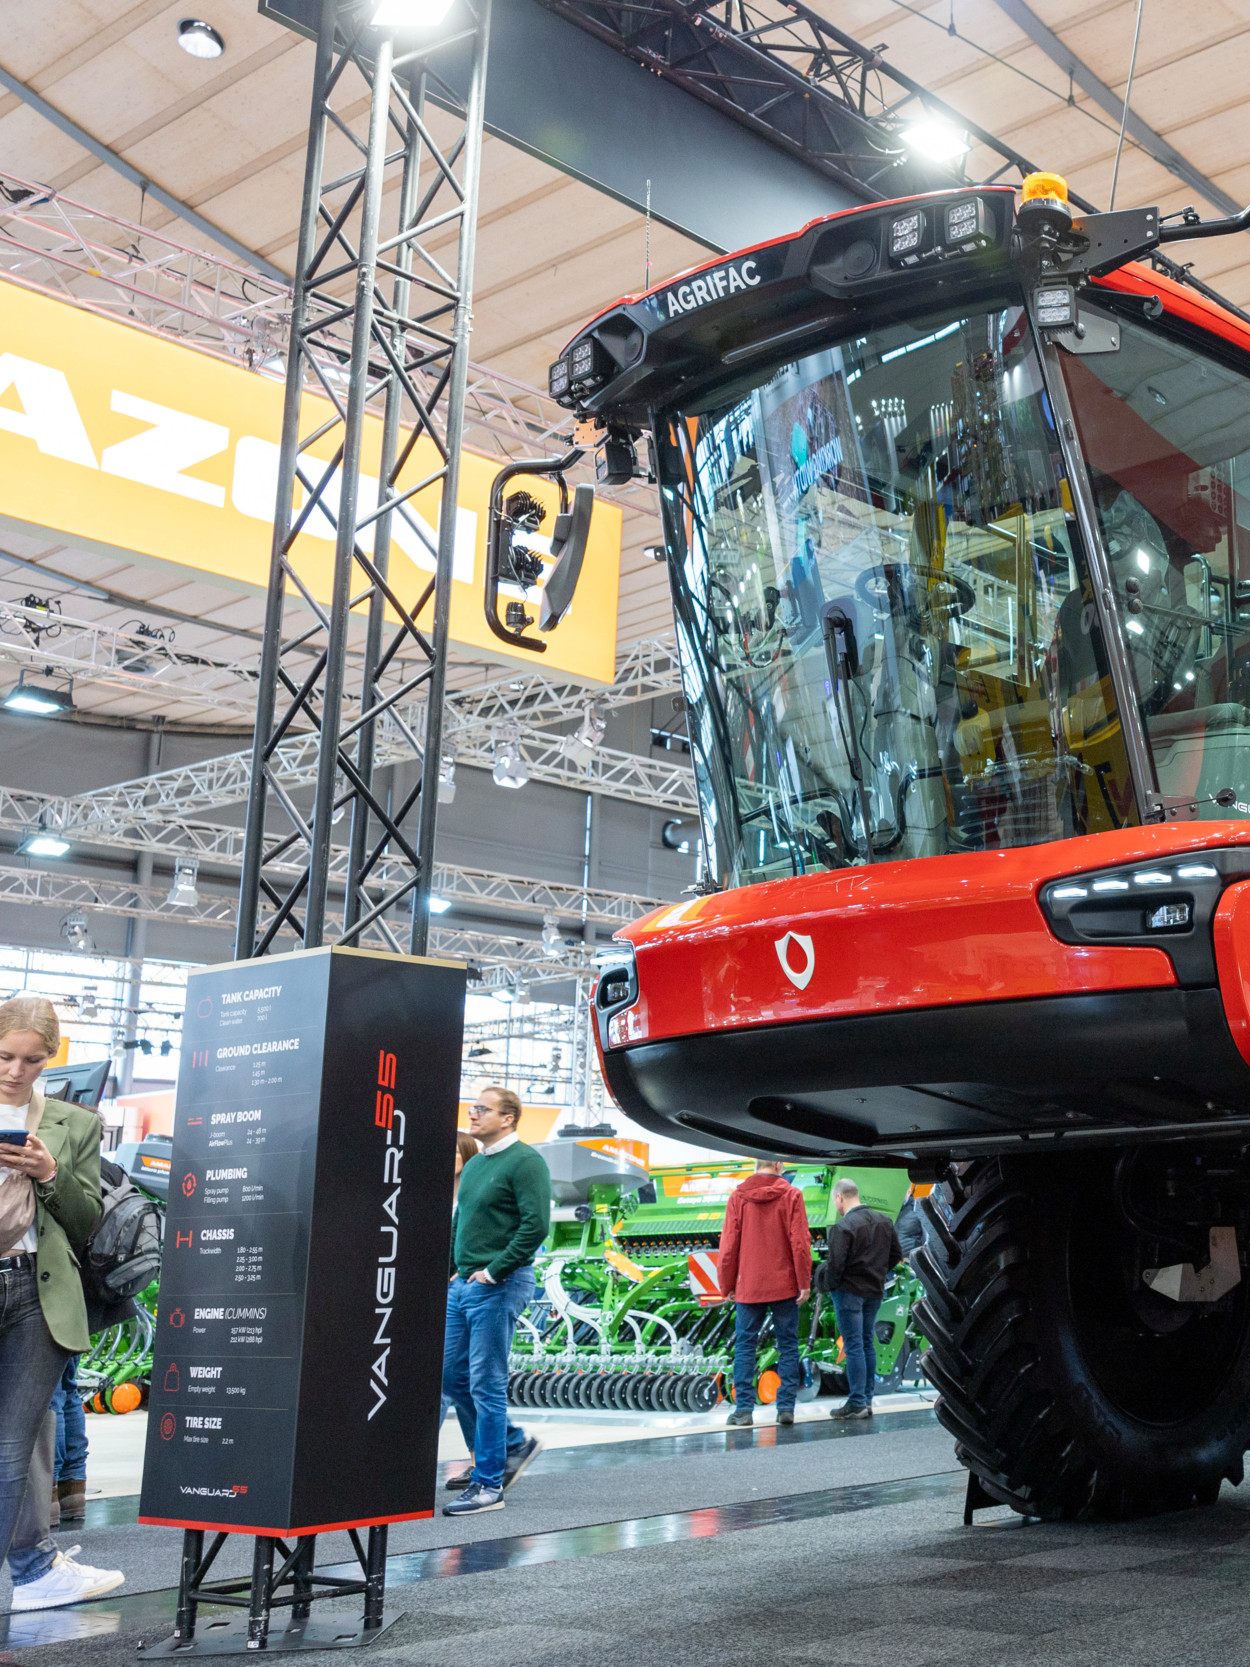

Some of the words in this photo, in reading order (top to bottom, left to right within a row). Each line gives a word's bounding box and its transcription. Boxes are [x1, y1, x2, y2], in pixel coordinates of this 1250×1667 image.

[667, 260, 761, 318] AGRIFAC
[222, 991, 242, 1004] TANK
[243, 986, 282, 1002] CAPACITY
[217, 1045, 251, 1059] GROUND
[252, 1038, 300, 1055] CLEARANCE
[211, 1112, 236, 1125] SPRAY
[237, 1110, 261, 1123] BOOM
[206, 1168, 247, 1181] PLUMBING
[201, 1228, 234, 1240] CHASSIS
[194, 1308, 224, 1319] ENGINE
[225, 1307, 267, 1319] (CUMMINS)
[190, 1366, 222, 1378] WEIGHT
[188, 1385, 201, 1393] Empty
[201, 1386, 215, 1395] weight
[185, 1416, 203, 1428] TIRE
[204, 1417, 222, 1429] SIZE
